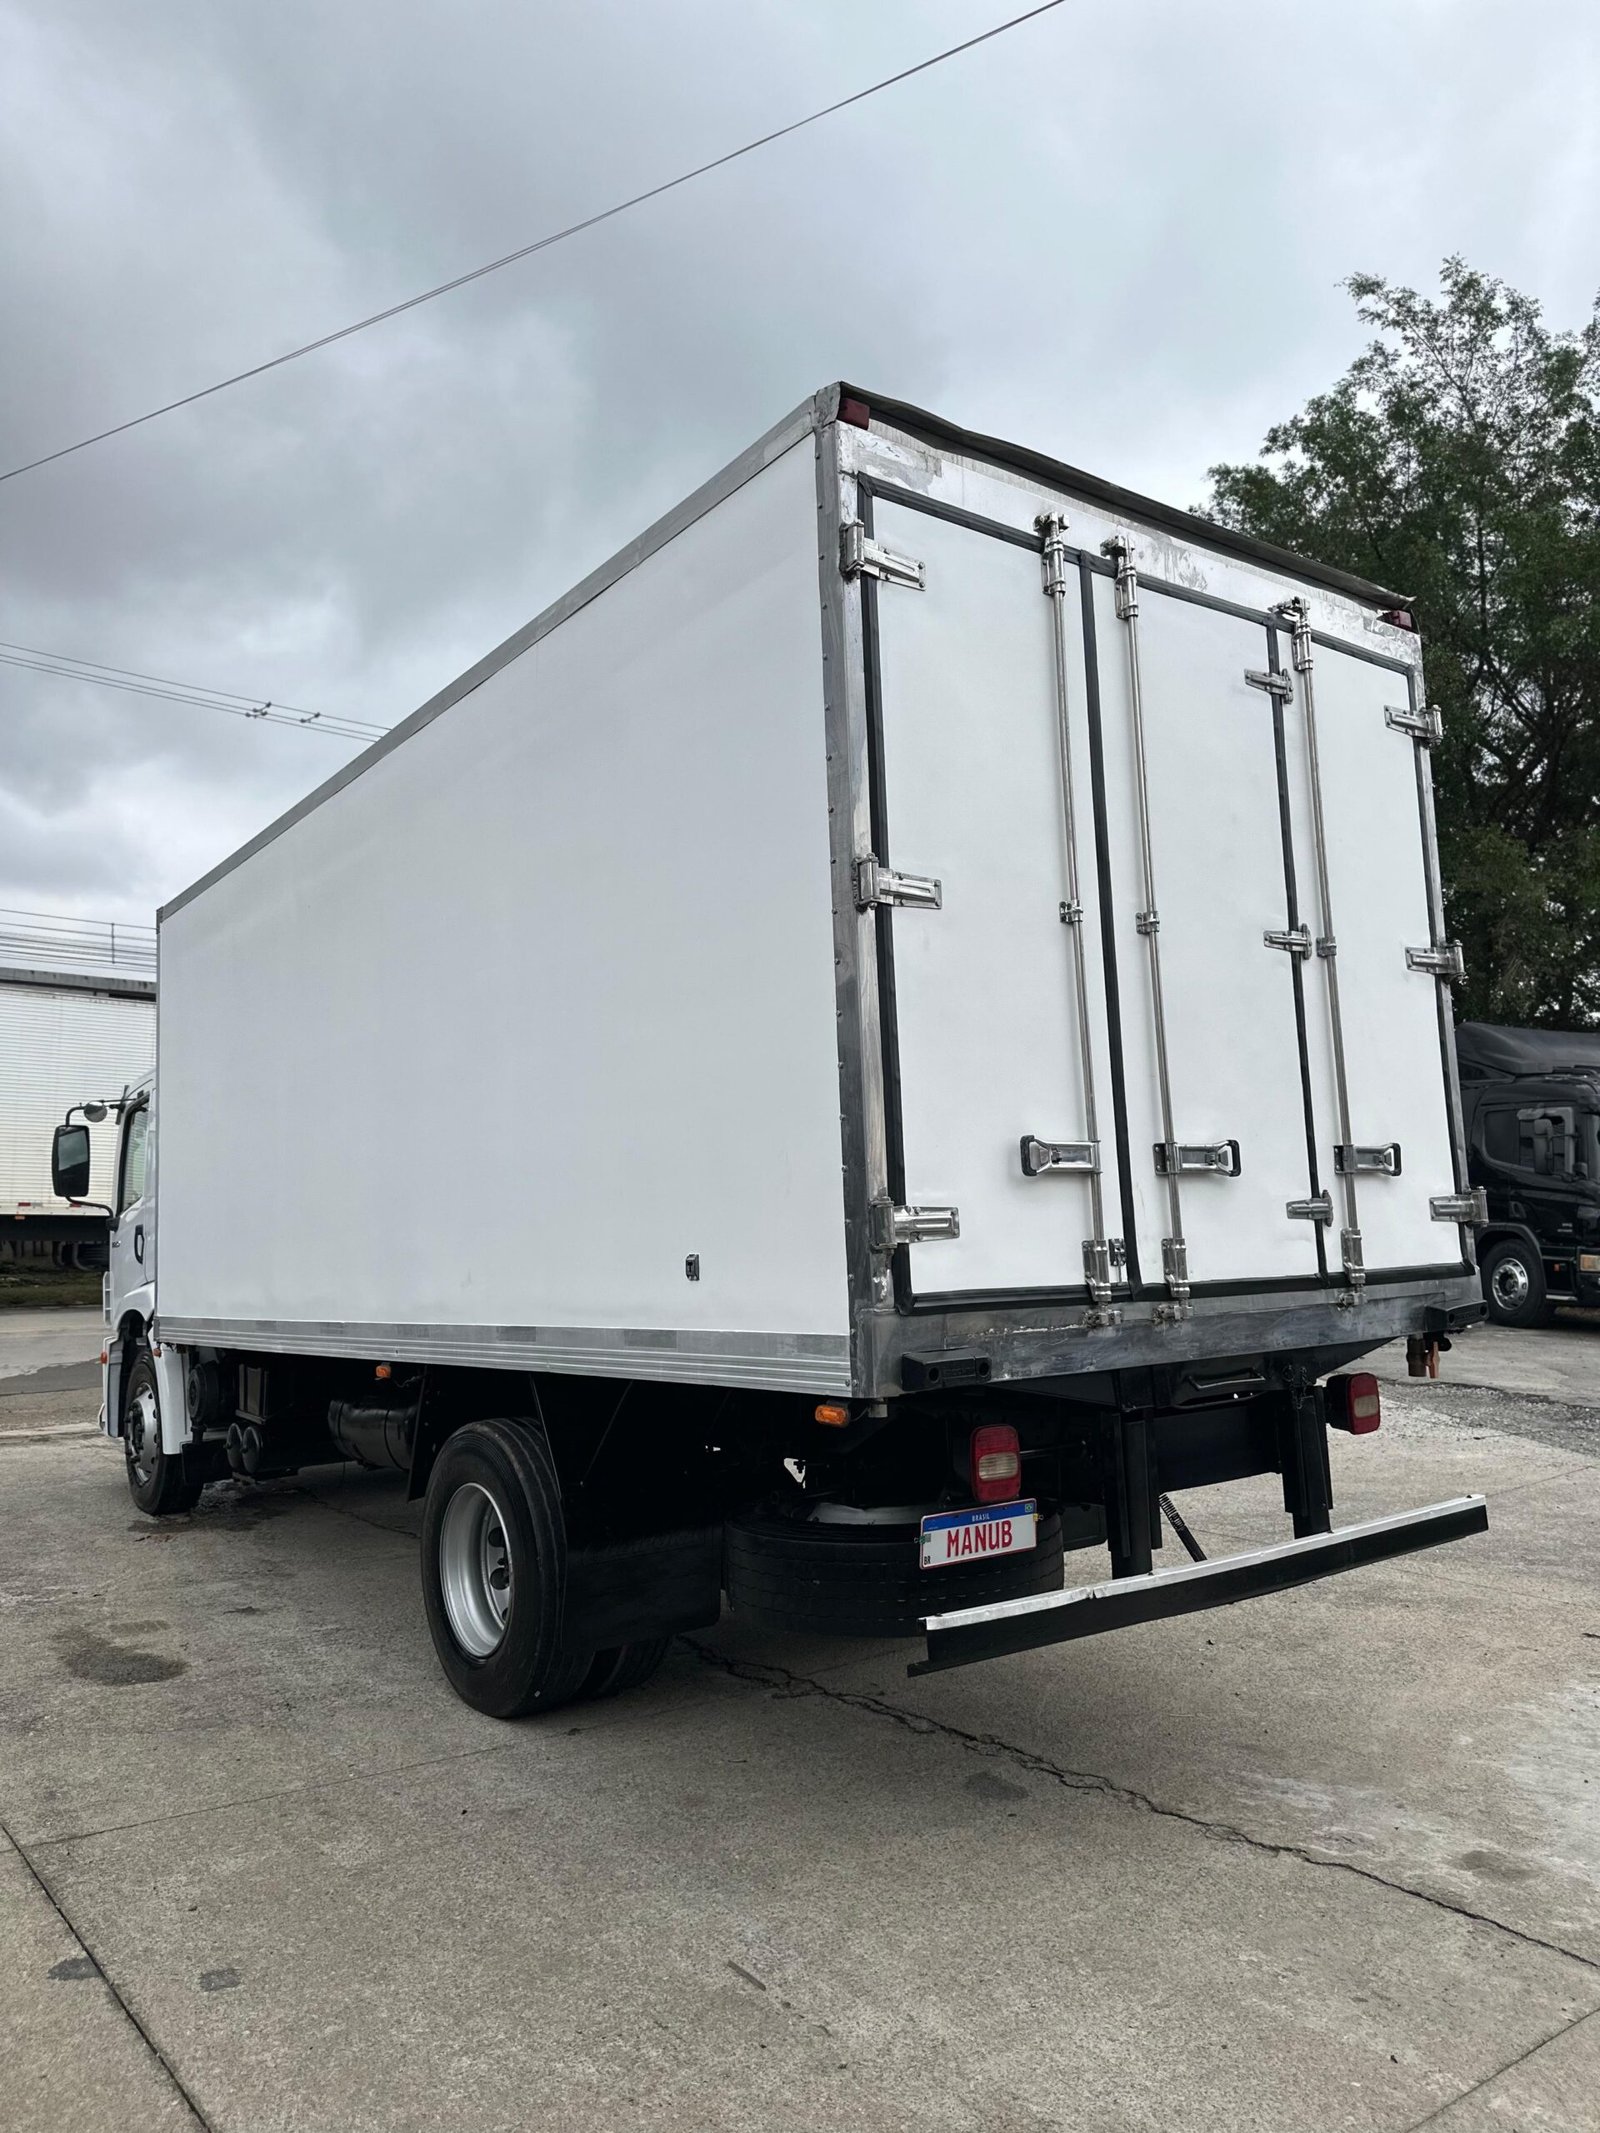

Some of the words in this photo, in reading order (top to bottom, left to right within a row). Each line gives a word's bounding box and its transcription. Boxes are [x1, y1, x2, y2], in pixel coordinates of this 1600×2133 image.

[972, 1513, 990, 1522] BRASIL
[947, 1520, 1013, 1558] MANUB
[924, 1555, 931, 1565] BR
